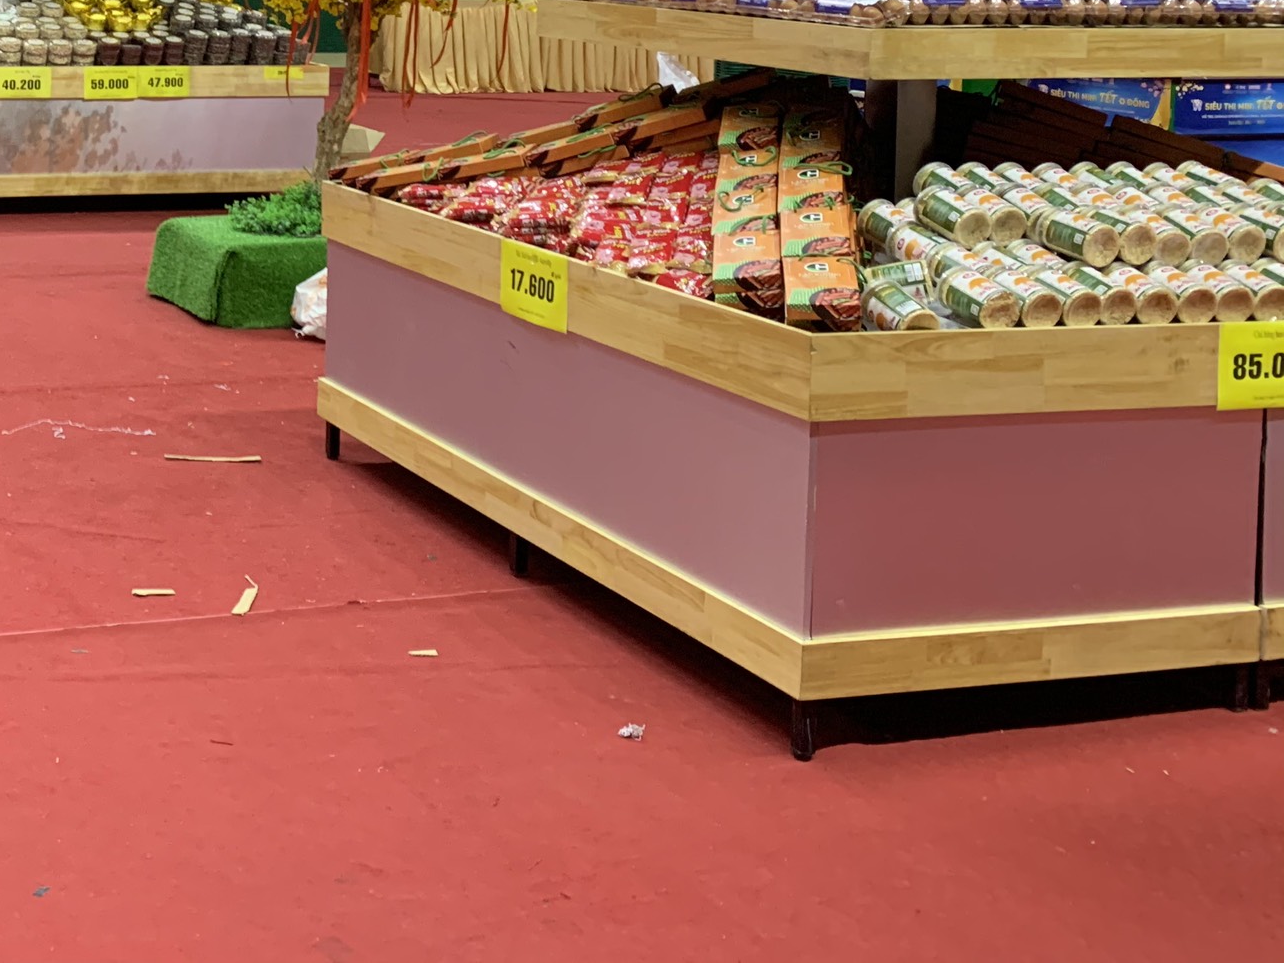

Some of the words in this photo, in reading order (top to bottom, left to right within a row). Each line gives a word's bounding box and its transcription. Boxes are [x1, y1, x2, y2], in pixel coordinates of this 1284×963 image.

[2, 79, 41, 90] 40.200
[90, 79, 129, 90] 59.000
[147, 77, 183, 88] 47.900
[510, 268, 555, 303] 17.600
